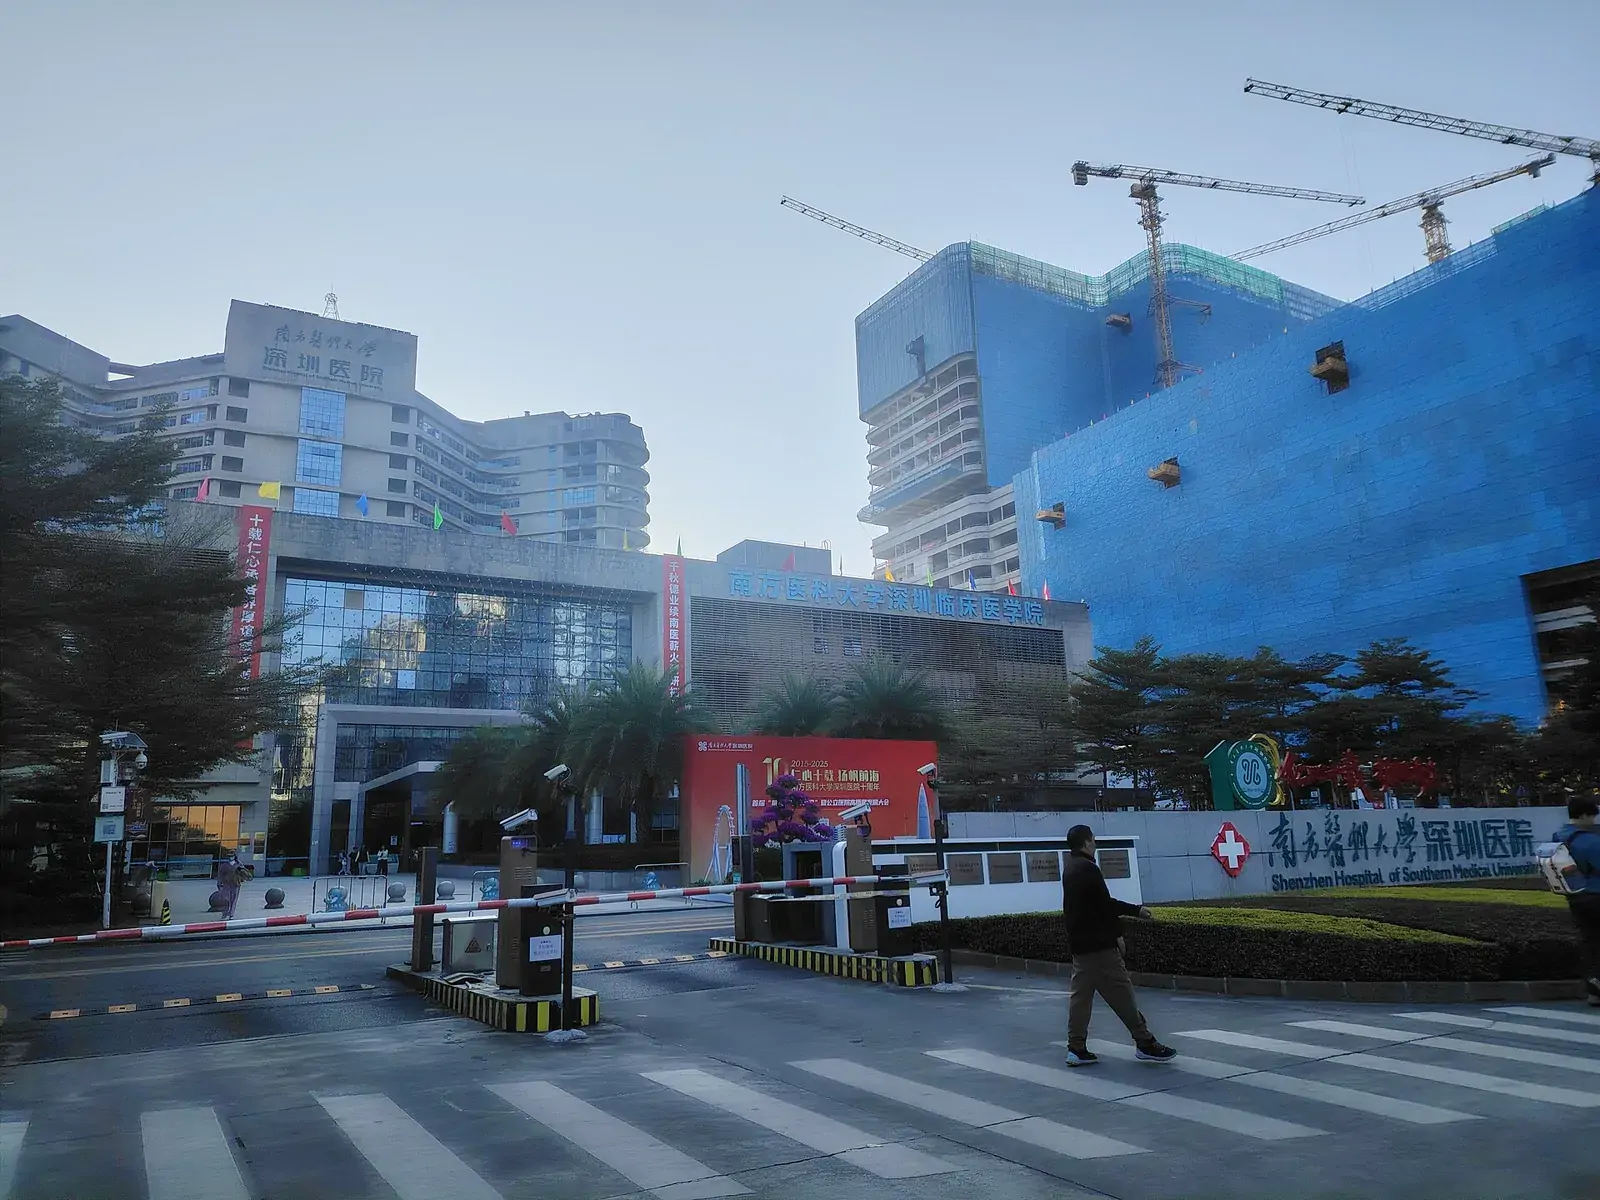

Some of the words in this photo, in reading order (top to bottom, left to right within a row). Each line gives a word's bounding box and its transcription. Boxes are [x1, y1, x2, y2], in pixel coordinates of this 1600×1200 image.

[263, 346, 384, 385] 深圳医院
[728, 568, 1043, 625] 南方医科大学深圳临床医学院
[791, 760, 829, 768] 2015-2025
[791, 769, 834, 782] 仁心十载
[838, 769, 879, 782] 扬帆前海
[1271, 872, 1332, 891] Shenzhen
[1334, 868, 1384, 888] Hospital
[1389, 866, 1400, 883] of
[1402, 864, 1451, 882] Southern
[1453, 862, 1492, 880] Medical
